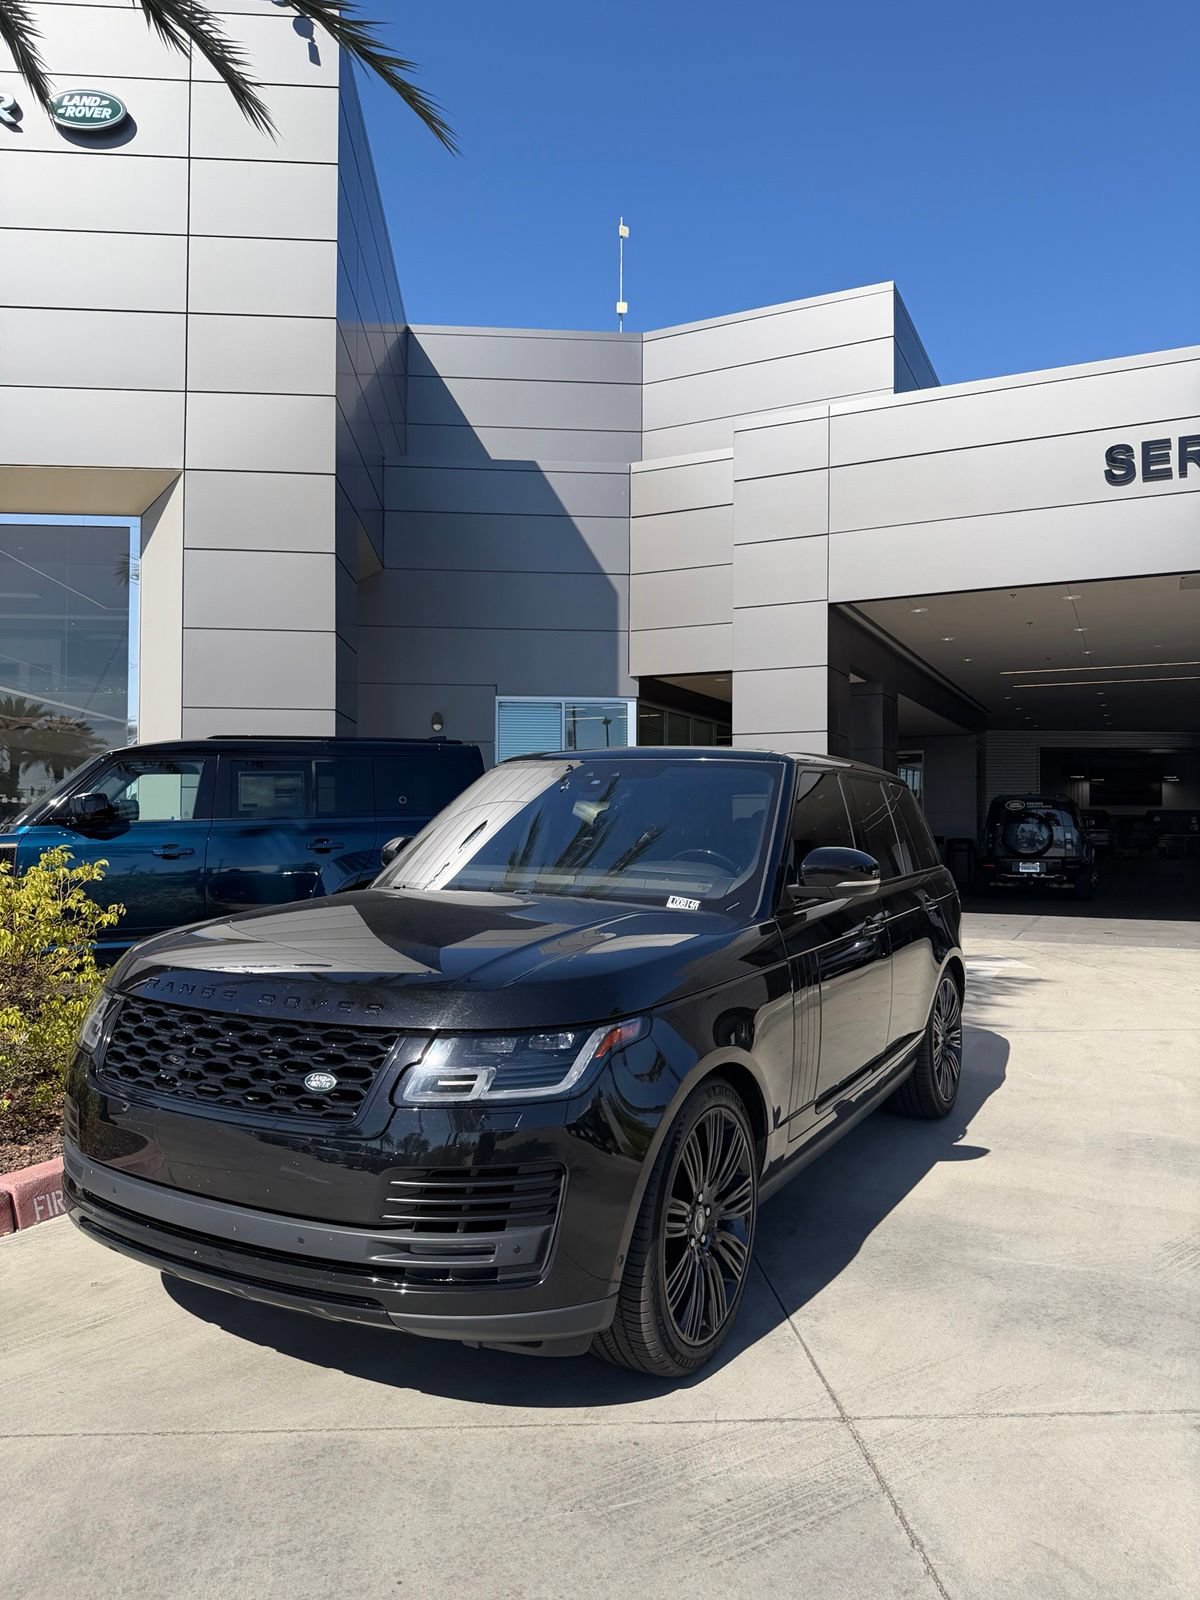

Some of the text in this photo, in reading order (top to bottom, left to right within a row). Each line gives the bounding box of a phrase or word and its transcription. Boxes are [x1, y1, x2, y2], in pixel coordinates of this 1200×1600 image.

[61, 95, 101, 107] LAND
[64, 106, 112, 119] ROVER
[145, 977, 385, 1016] RANGE ROVER
[310, 1074, 328, 1082] LAND
